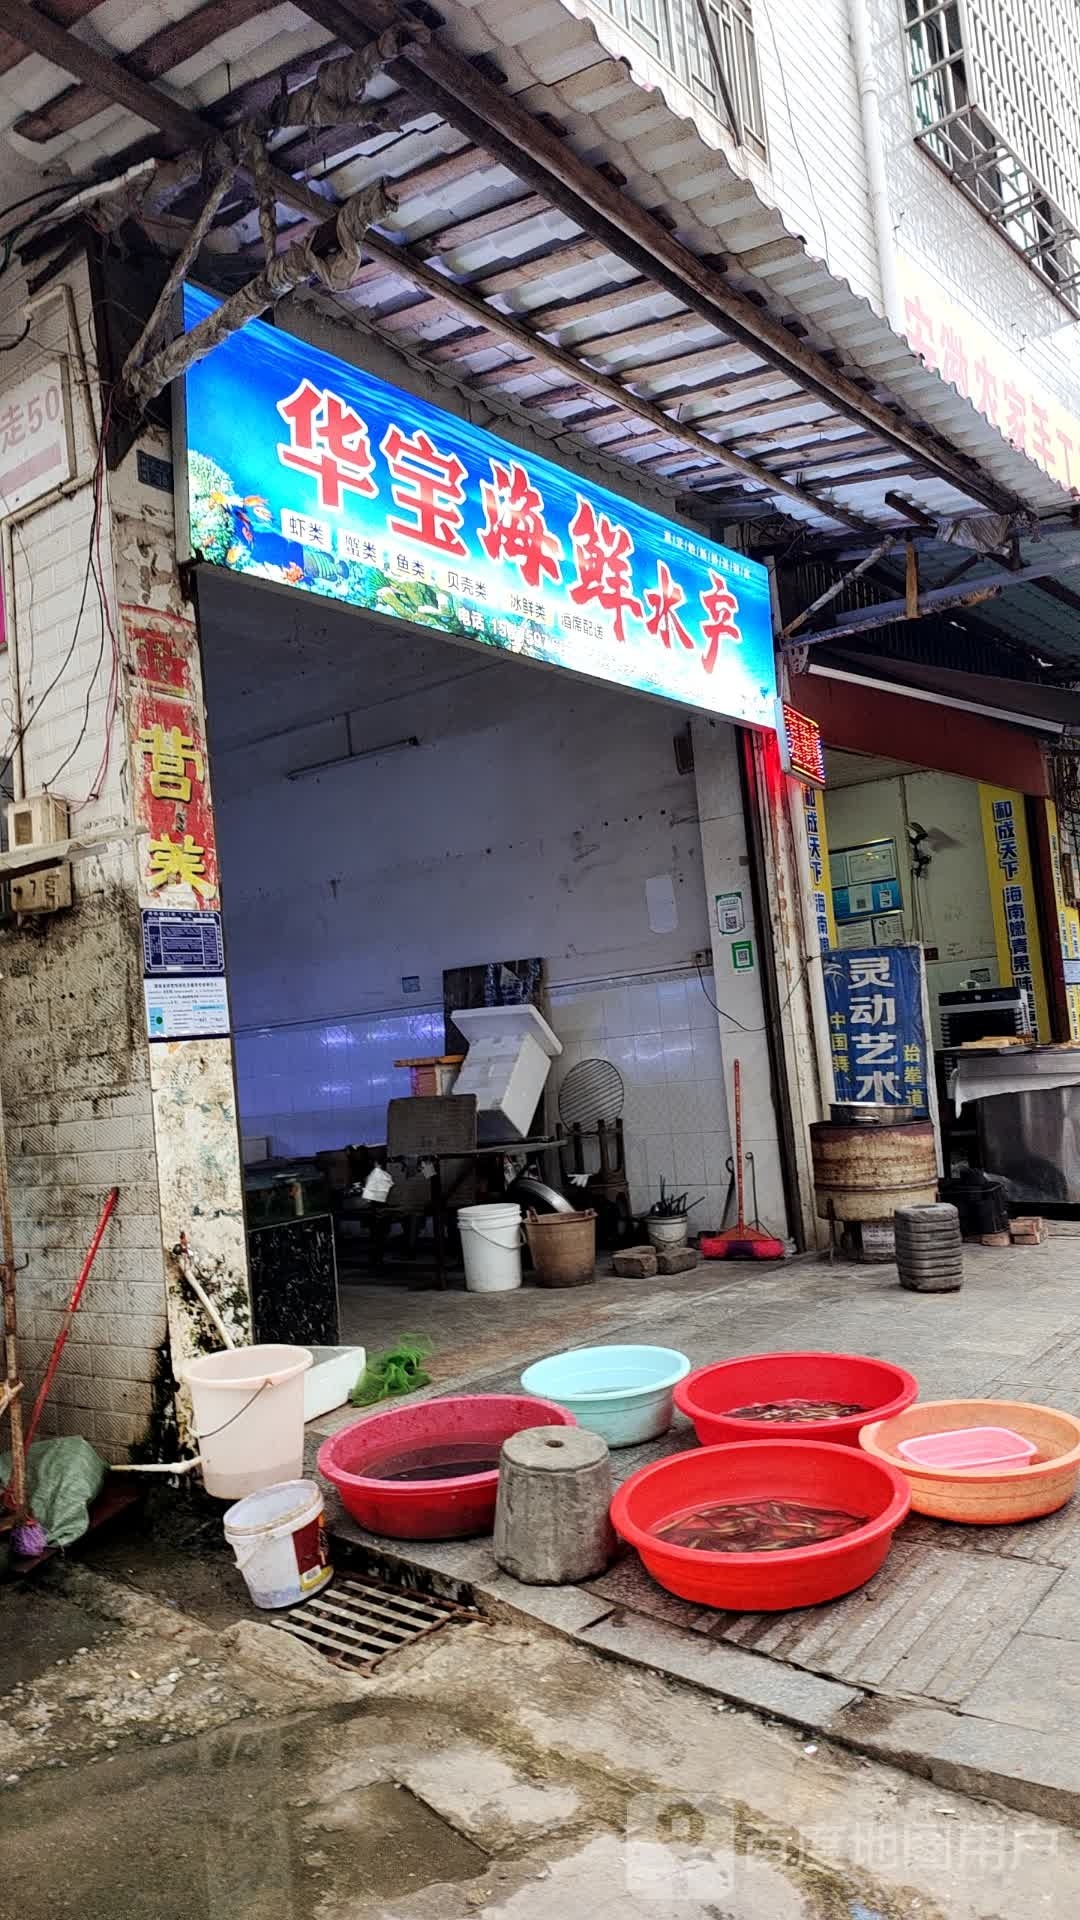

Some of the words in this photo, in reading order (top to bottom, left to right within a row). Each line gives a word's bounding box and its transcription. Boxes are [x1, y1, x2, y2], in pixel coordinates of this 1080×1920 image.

[276, 378, 742, 674] 华宝海鲜水产
[288, 515, 326, 547] 虾类
[344, 535, 377, 564] 蟹类
[396, 553, 425, 579] 鱼类
[447, 571, 488, 601] 贝壳类
[510, 592, 546, 622] 冰鲜类
[993, 799, 1019, 880] 和成天下
[830, 1011, 852, 1102] 中国舞、
[848, 956, 902, 1104] 灵动艺术
[903, 1043, 923, 1105] 跆拳道
